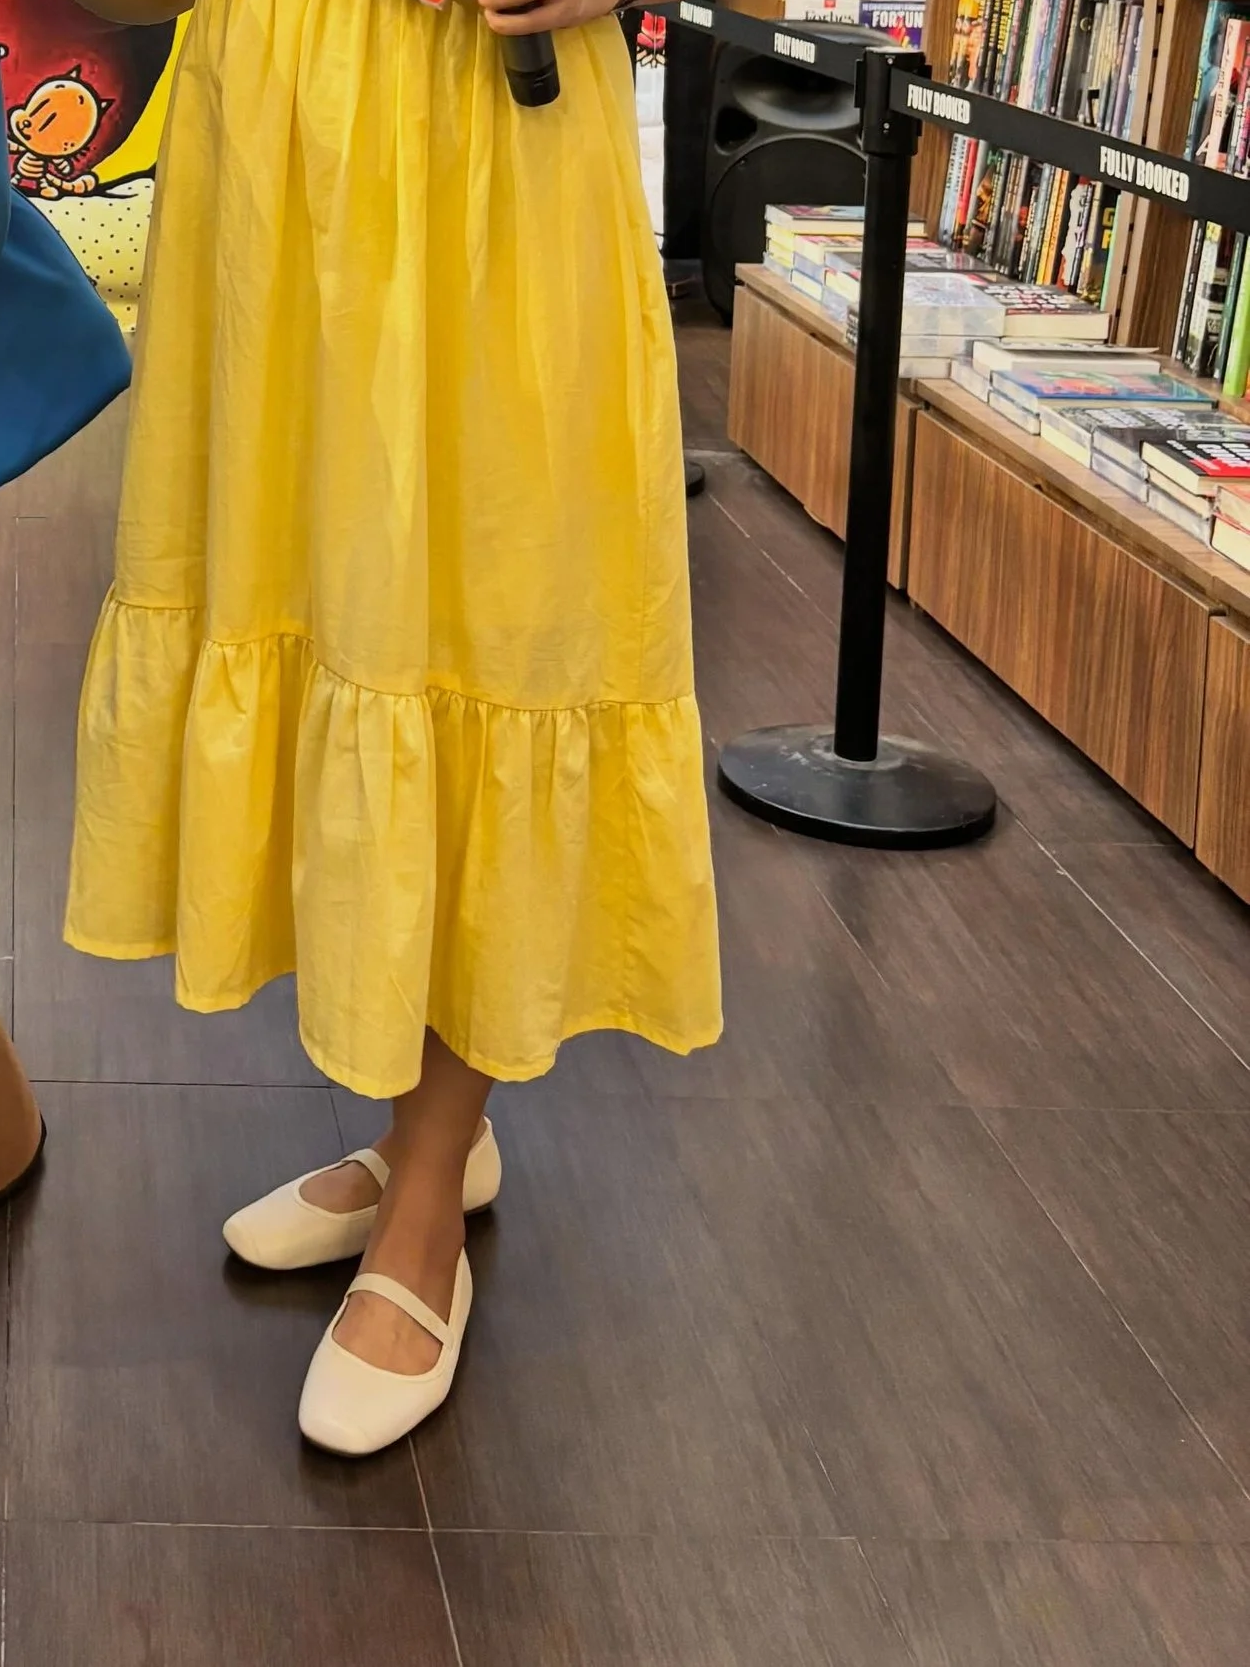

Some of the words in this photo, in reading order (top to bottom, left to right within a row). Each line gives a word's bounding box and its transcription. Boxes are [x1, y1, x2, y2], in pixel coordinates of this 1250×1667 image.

[679, 0, 693, 23] FULLY
[692, 4, 713, 28] BOOKED
[872, 10, 924, 29] FORTUN
[773, 32, 791, 57] FULLY
[790, 38, 817, 64] BOOKED
[907, 82, 933, 113] FULLY
[932, 91, 971, 125] BOOKED
[1099, 145, 1136, 181] FULLY
[1135, 157, 1190, 203] BOOKED
